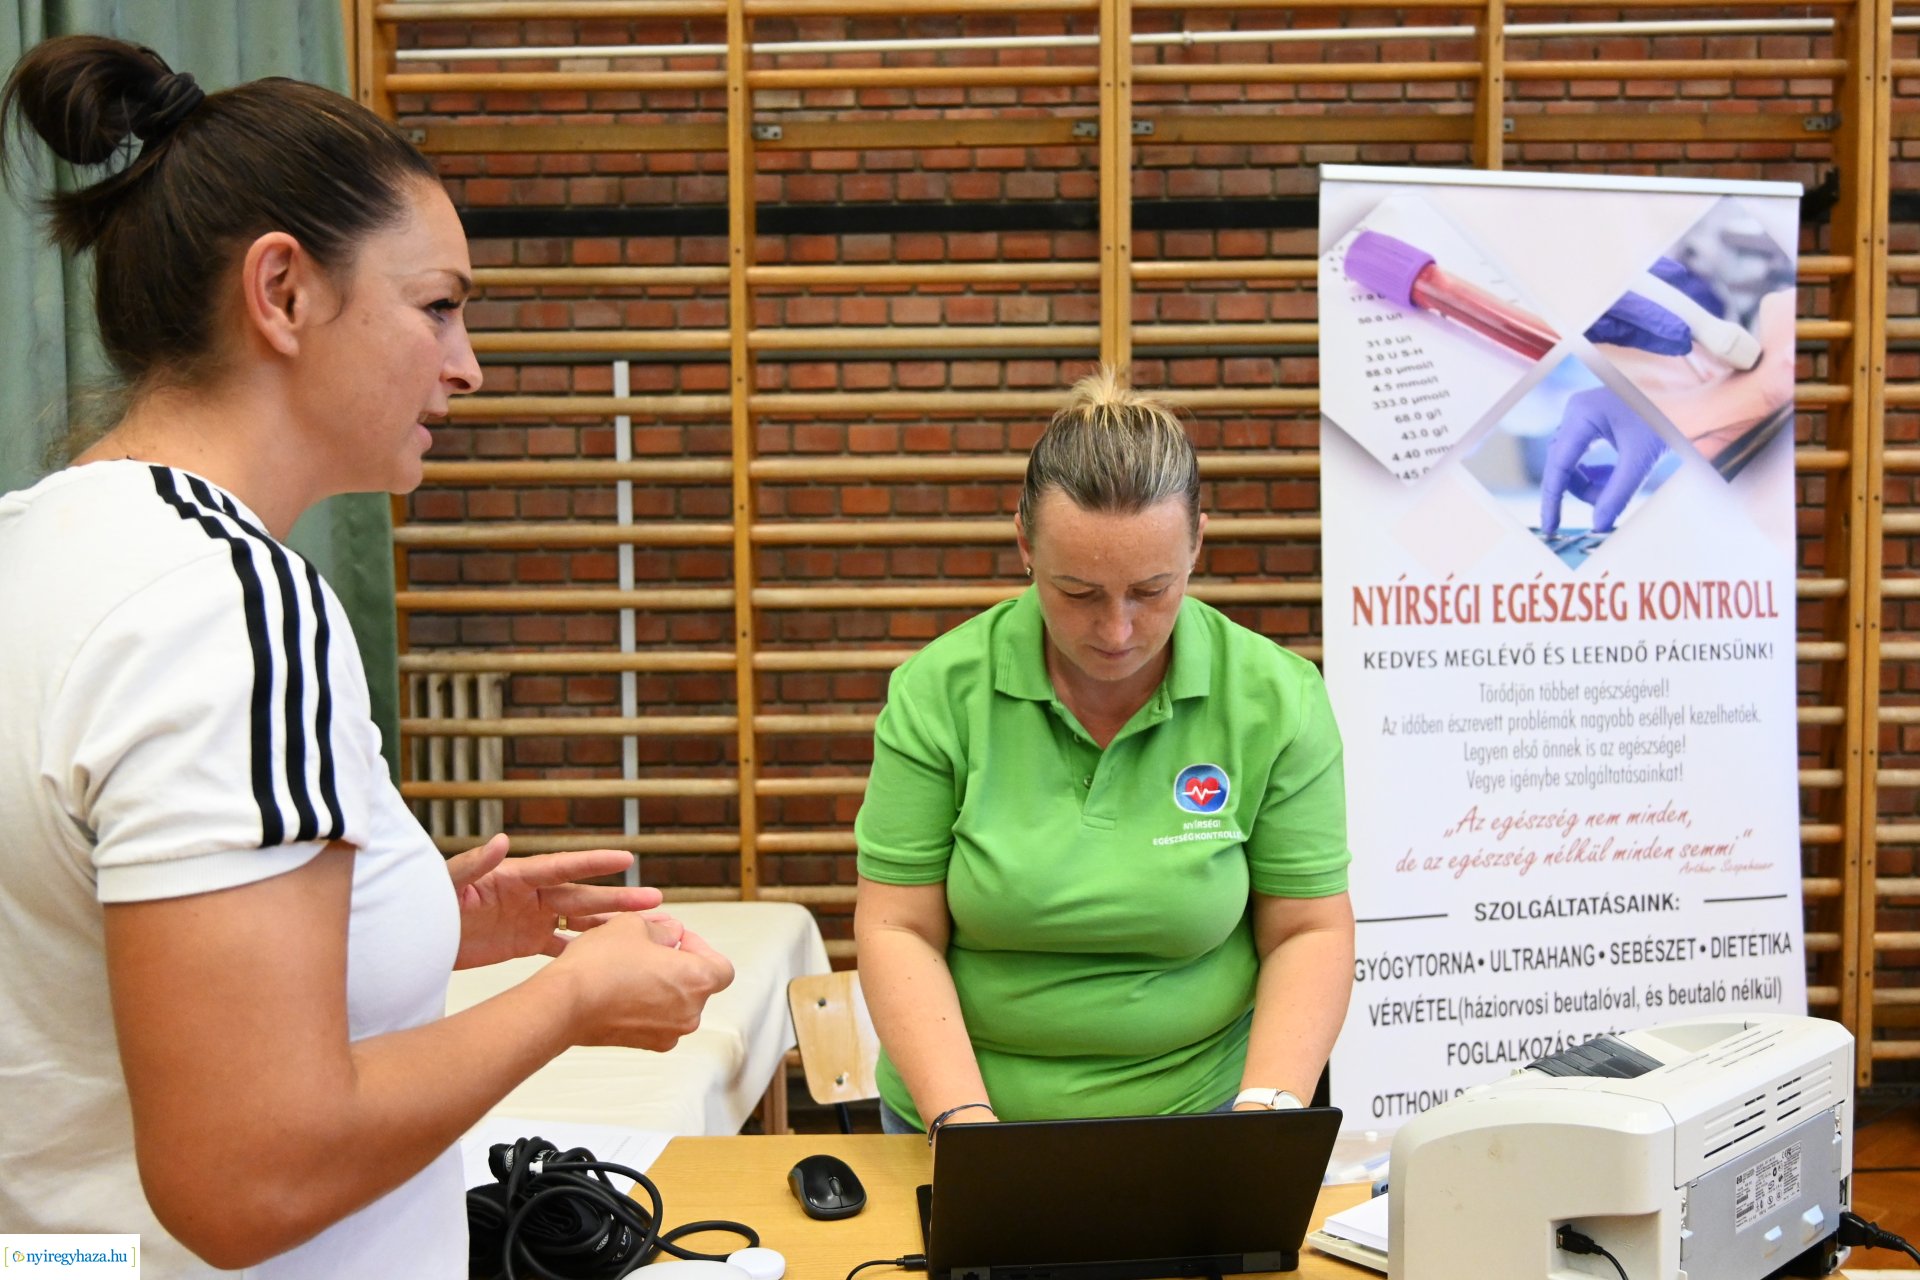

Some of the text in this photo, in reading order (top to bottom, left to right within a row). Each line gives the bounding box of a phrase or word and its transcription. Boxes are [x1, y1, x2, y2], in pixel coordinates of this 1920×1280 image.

[1352, 571, 1779, 626] NYÍRSÉGI EGÉSZSÉG KONTROLL
[1363, 637, 1774, 669] KEDVES MEGLÉVŐ ÉS LEENDŐ PÁCIENSÜNK!
[1479, 677, 1670, 706] Törődjön többet egészségével!
[1382, 715, 1398, 736] Az
[1402, 713, 1443, 735] időben
[1448, 712, 1503, 733] észrevett
[1508, 708, 1577, 735] problémák
[1581, 707, 1634, 732] nagyobb
[1638, 705, 1685, 730] eséllyel
[1464, 735, 1686, 766] Legyen első önnek is az egészsége!
[1466, 762, 1683, 794] Vegye igénybe szolgáltatásainkat!
[1490, 808, 1579, 841] egészség
[1585, 813, 1620, 828] nem
[1626, 800, 1692, 828] minden,
[1395, 848, 1417, 873] de
[1423, 856, 1443, 871] az
[1448, 847, 1537, 880] egészség
[1544, 836, 1615, 866] nélkül
[1612, 836, 1674, 862] minden
[1475, 893, 1680, 921] SZOLGÁLTATÁSAINK:
[1490, 944, 1596, 972] ULTRAHANG
[1610, 935, 1696, 965] SEBÉSZET
[1711, 929, 1793, 958] DIETÉTIKA
[1554, 986, 1641, 1015] beutalóval,
[1645, 985, 1663, 1008] és
[1668, 979, 1726, 1006] beutaló
[1732, 976, 1783, 1005] nélkül)
[1447, 1030, 1576, 1066] FOGLALKOZÁS
